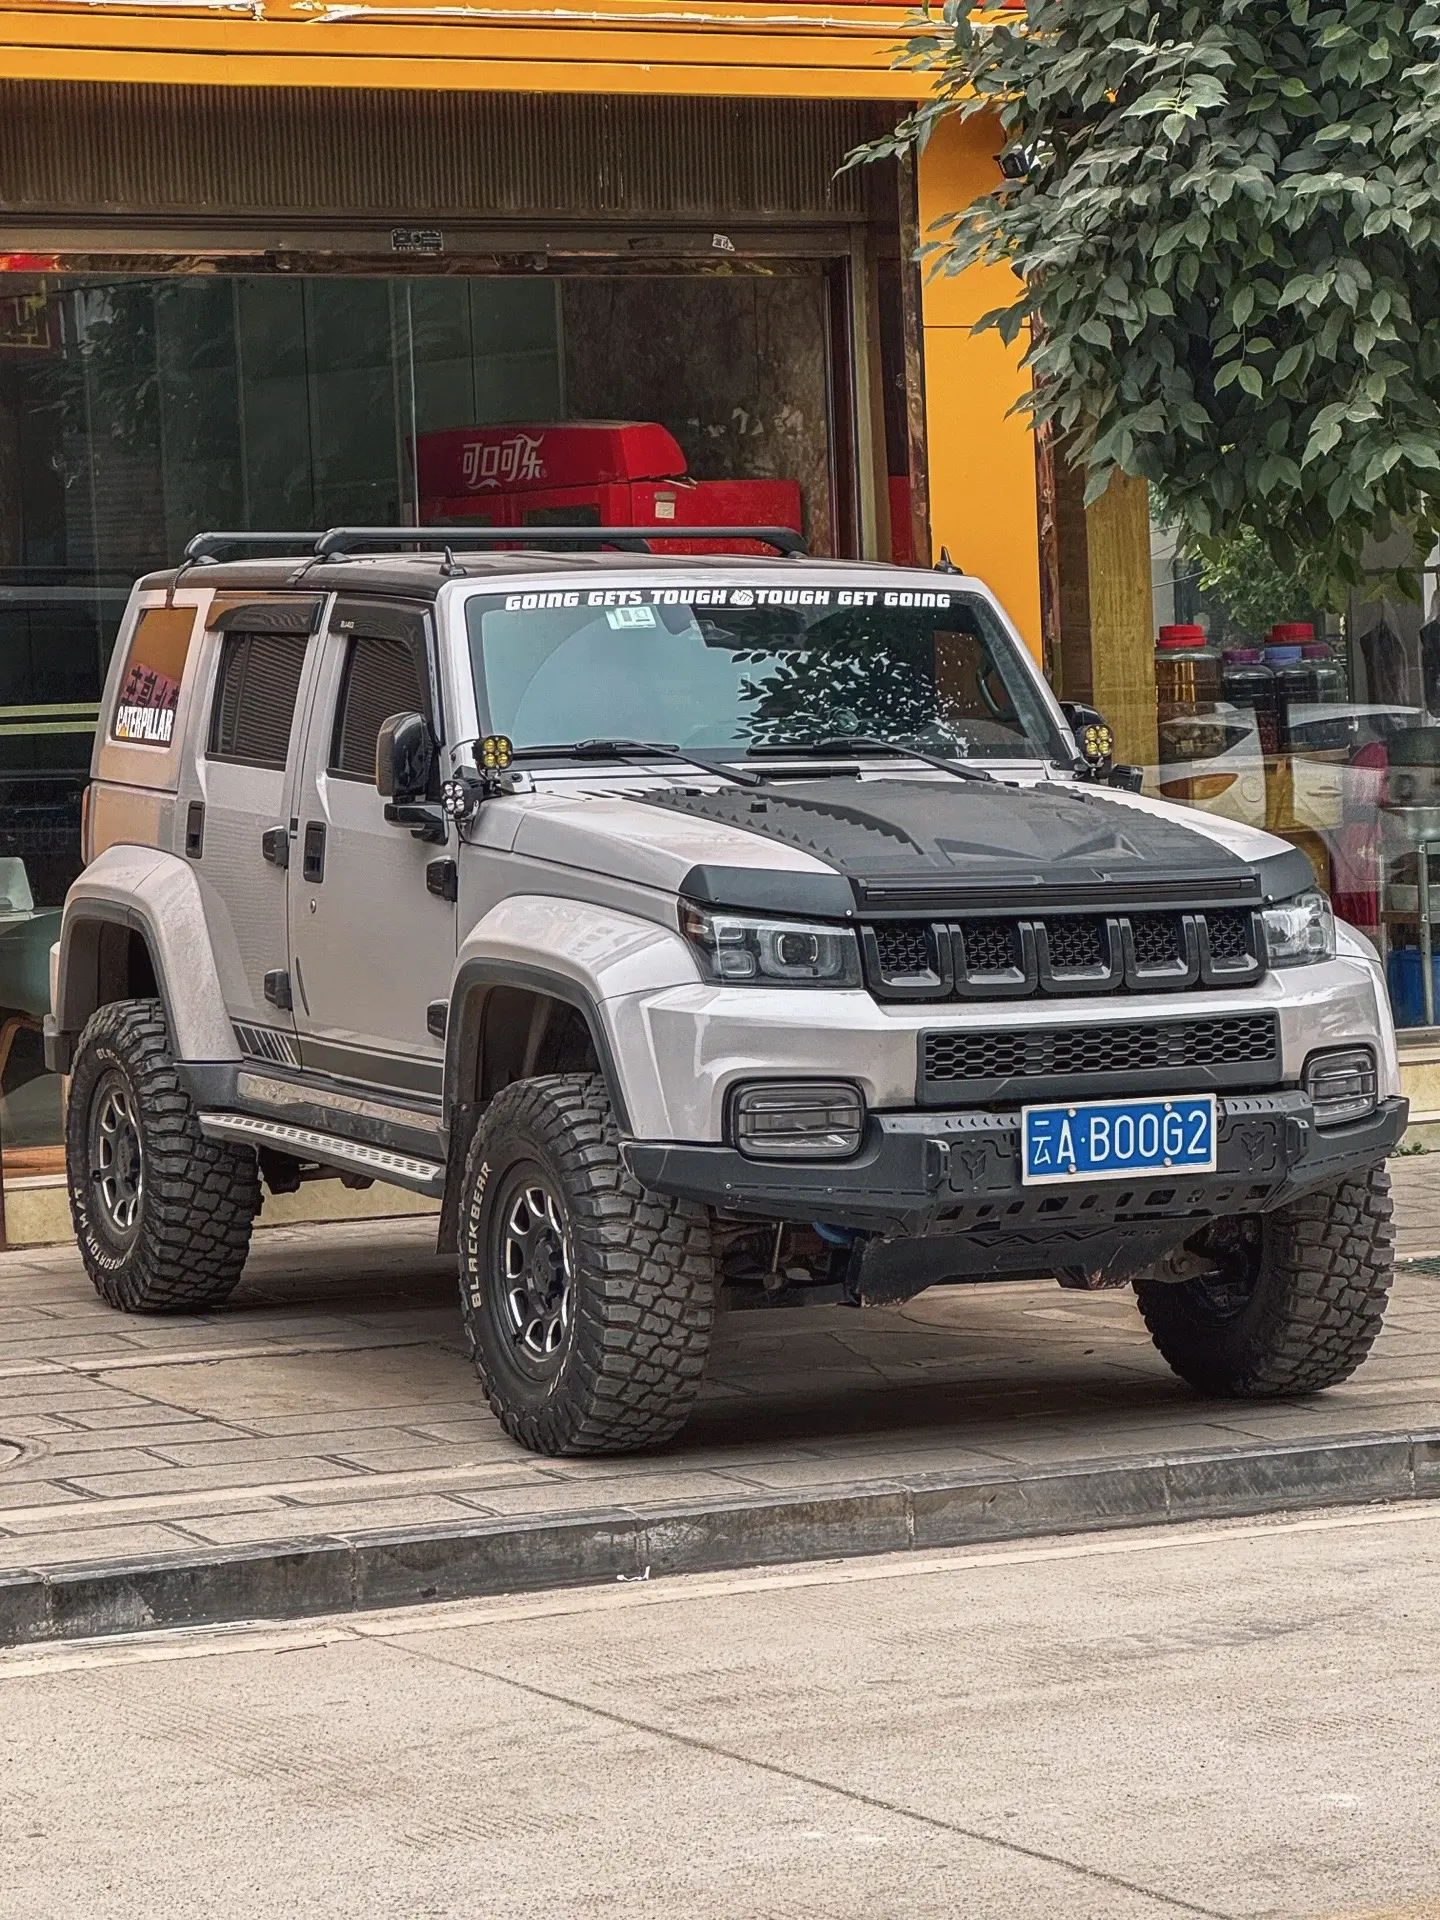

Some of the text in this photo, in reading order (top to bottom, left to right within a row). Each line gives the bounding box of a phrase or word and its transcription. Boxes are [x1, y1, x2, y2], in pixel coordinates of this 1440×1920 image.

[462, 432, 545, 489] 可口可乐
[505, 589, 951, 612] GOING GETS TOUGH TOUGH GET GOING
[115, 705, 174, 742] CATERPILLAR
[468, 1161, 493, 1309] BLACKBEAR
